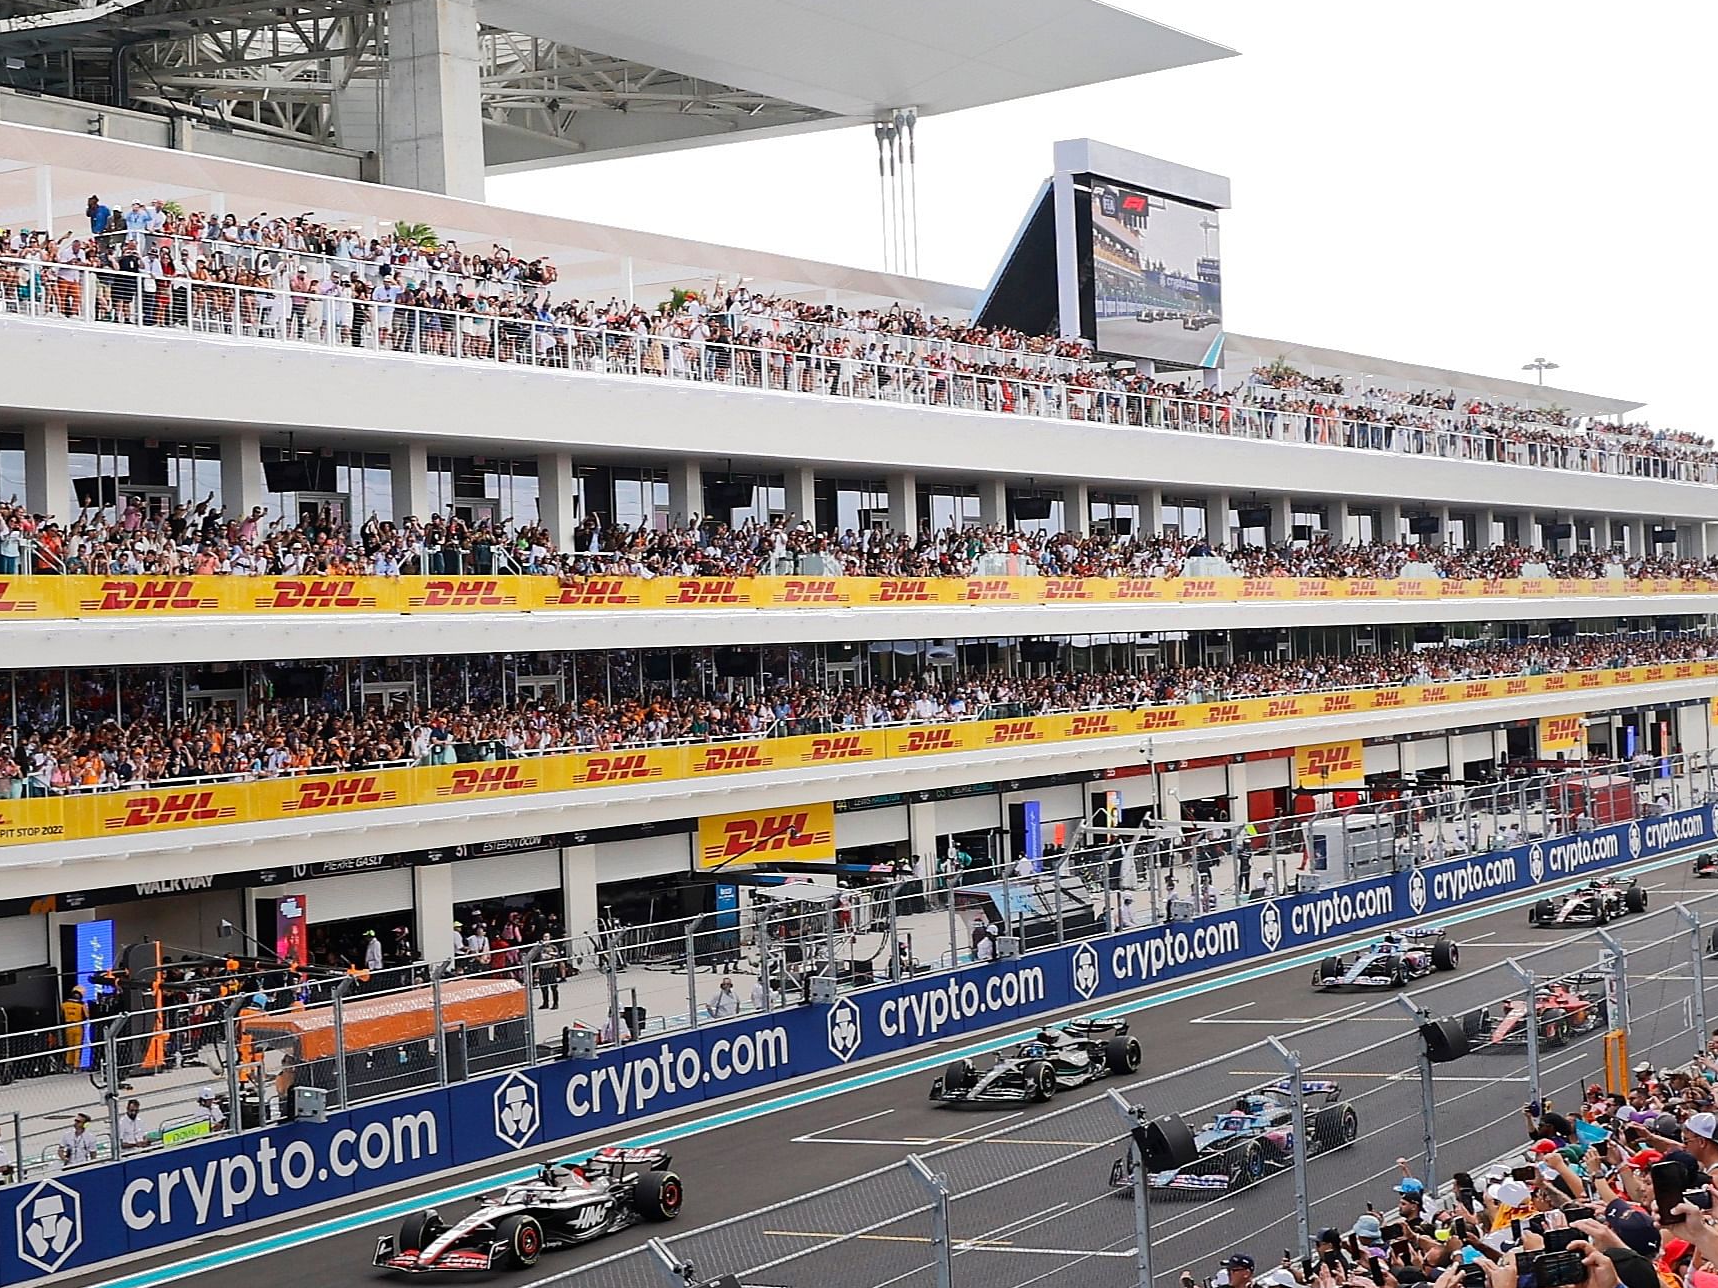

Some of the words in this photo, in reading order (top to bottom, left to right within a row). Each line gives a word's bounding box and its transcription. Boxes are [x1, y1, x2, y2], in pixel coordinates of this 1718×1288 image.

[100, 581, 203, 609] DHL
[272, 581, 362, 607] DHL
[423, 580, 504, 605] DHL
[556, 580, 625, 604] DHL
[677, 581, 738, 603] DHL
[784, 581, 838, 601] DHL
[878, 581, 930, 601] DHL
[966, 581, 1012, 600] DHL
[1044, 581, 1086, 598] DHL
[1116, 581, 1154, 598] DHL
[1208, 705, 1239, 722] DHL
[1268, 700, 1297, 717] DHL
[1323, 696, 1350, 712] DHL
[993, 722, 1036, 742] DHL
[1072, 716, 1110, 735] DHL
[1143, 711, 1177, 729] DHL
[1548, 718, 1580, 742] DHL
[813, 736, 861, 760] DHL
[907, 729, 955, 752] DHL
[585, 755, 650, 782] DHL
[705, 745, 762, 770] DHL
[1305, 747, 1354, 776] DHL
[297, 777, 381, 809] DHL
[450, 766, 523, 795] DHL
[124, 791, 219, 827] DHL
[0, 829, 15, 839] PIT
[17, 827, 40, 838] STOP
[43, 826, 64, 835] 2022
[723, 812, 819, 856] DHL
[1645, 813, 1704, 848] crypto.com
[1548, 833, 1618, 873] crypto.com
[1433, 855, 1516, 900] crypto.com
[1291, 884, 1392, 926] crypto.com
[1112, 919, 1240, 980] crypto.com
[879, 965, 1045, 1037] crypto.com
[565, 1027, 789, 1117] crypto.com
[120, 1108, 439, 1231] crypto.com
